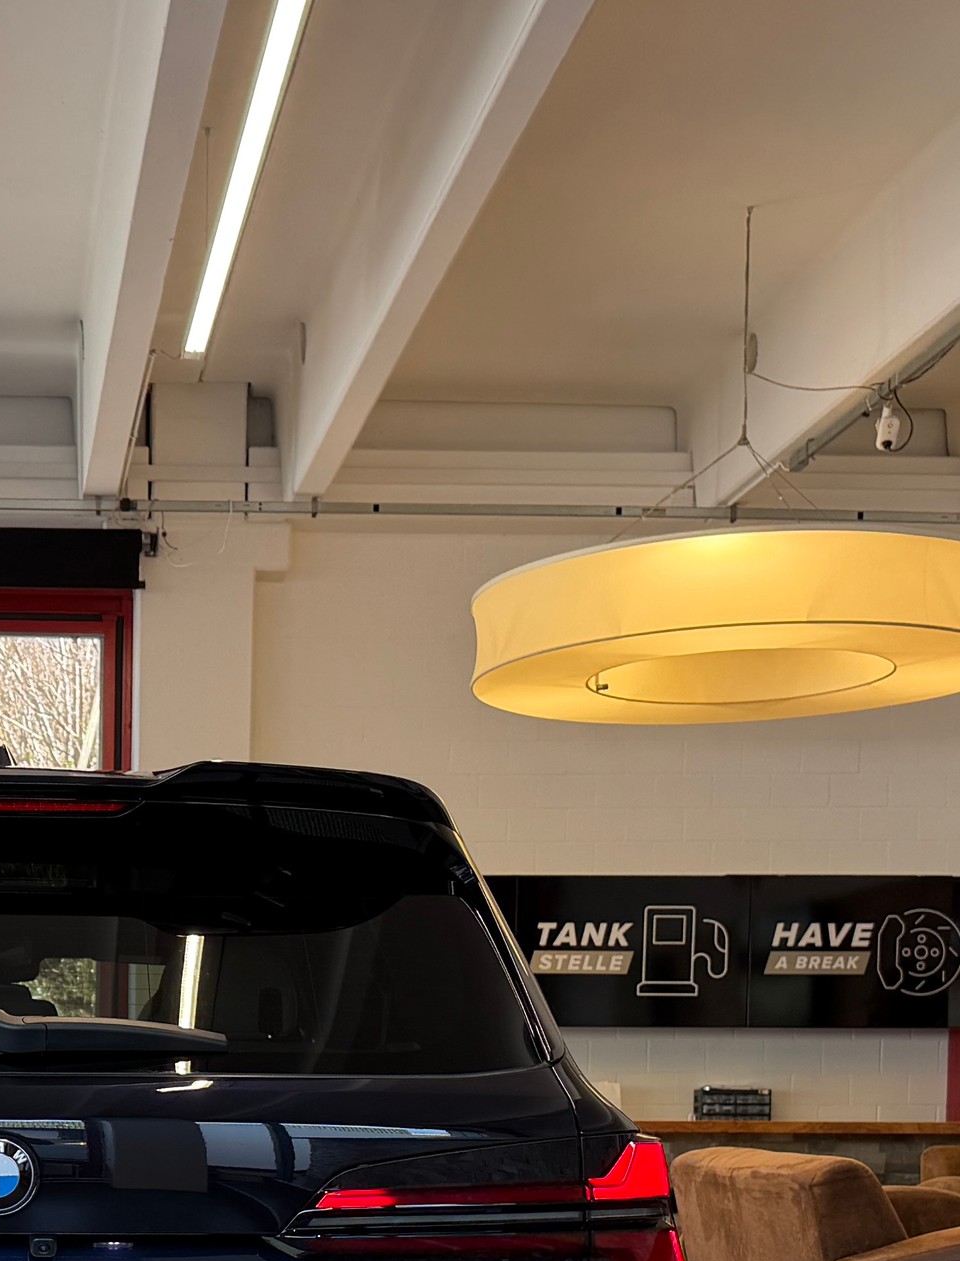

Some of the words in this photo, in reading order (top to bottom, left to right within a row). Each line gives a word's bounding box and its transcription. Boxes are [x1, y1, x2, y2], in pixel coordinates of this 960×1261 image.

[536, 922, 634, 947] TANK
[771, 922, 876, 947] HAVE
[538, 954, 624, 971] STELLE
[774, 955, 788, 970] A
[794, 955, 859, 970] BREAK
